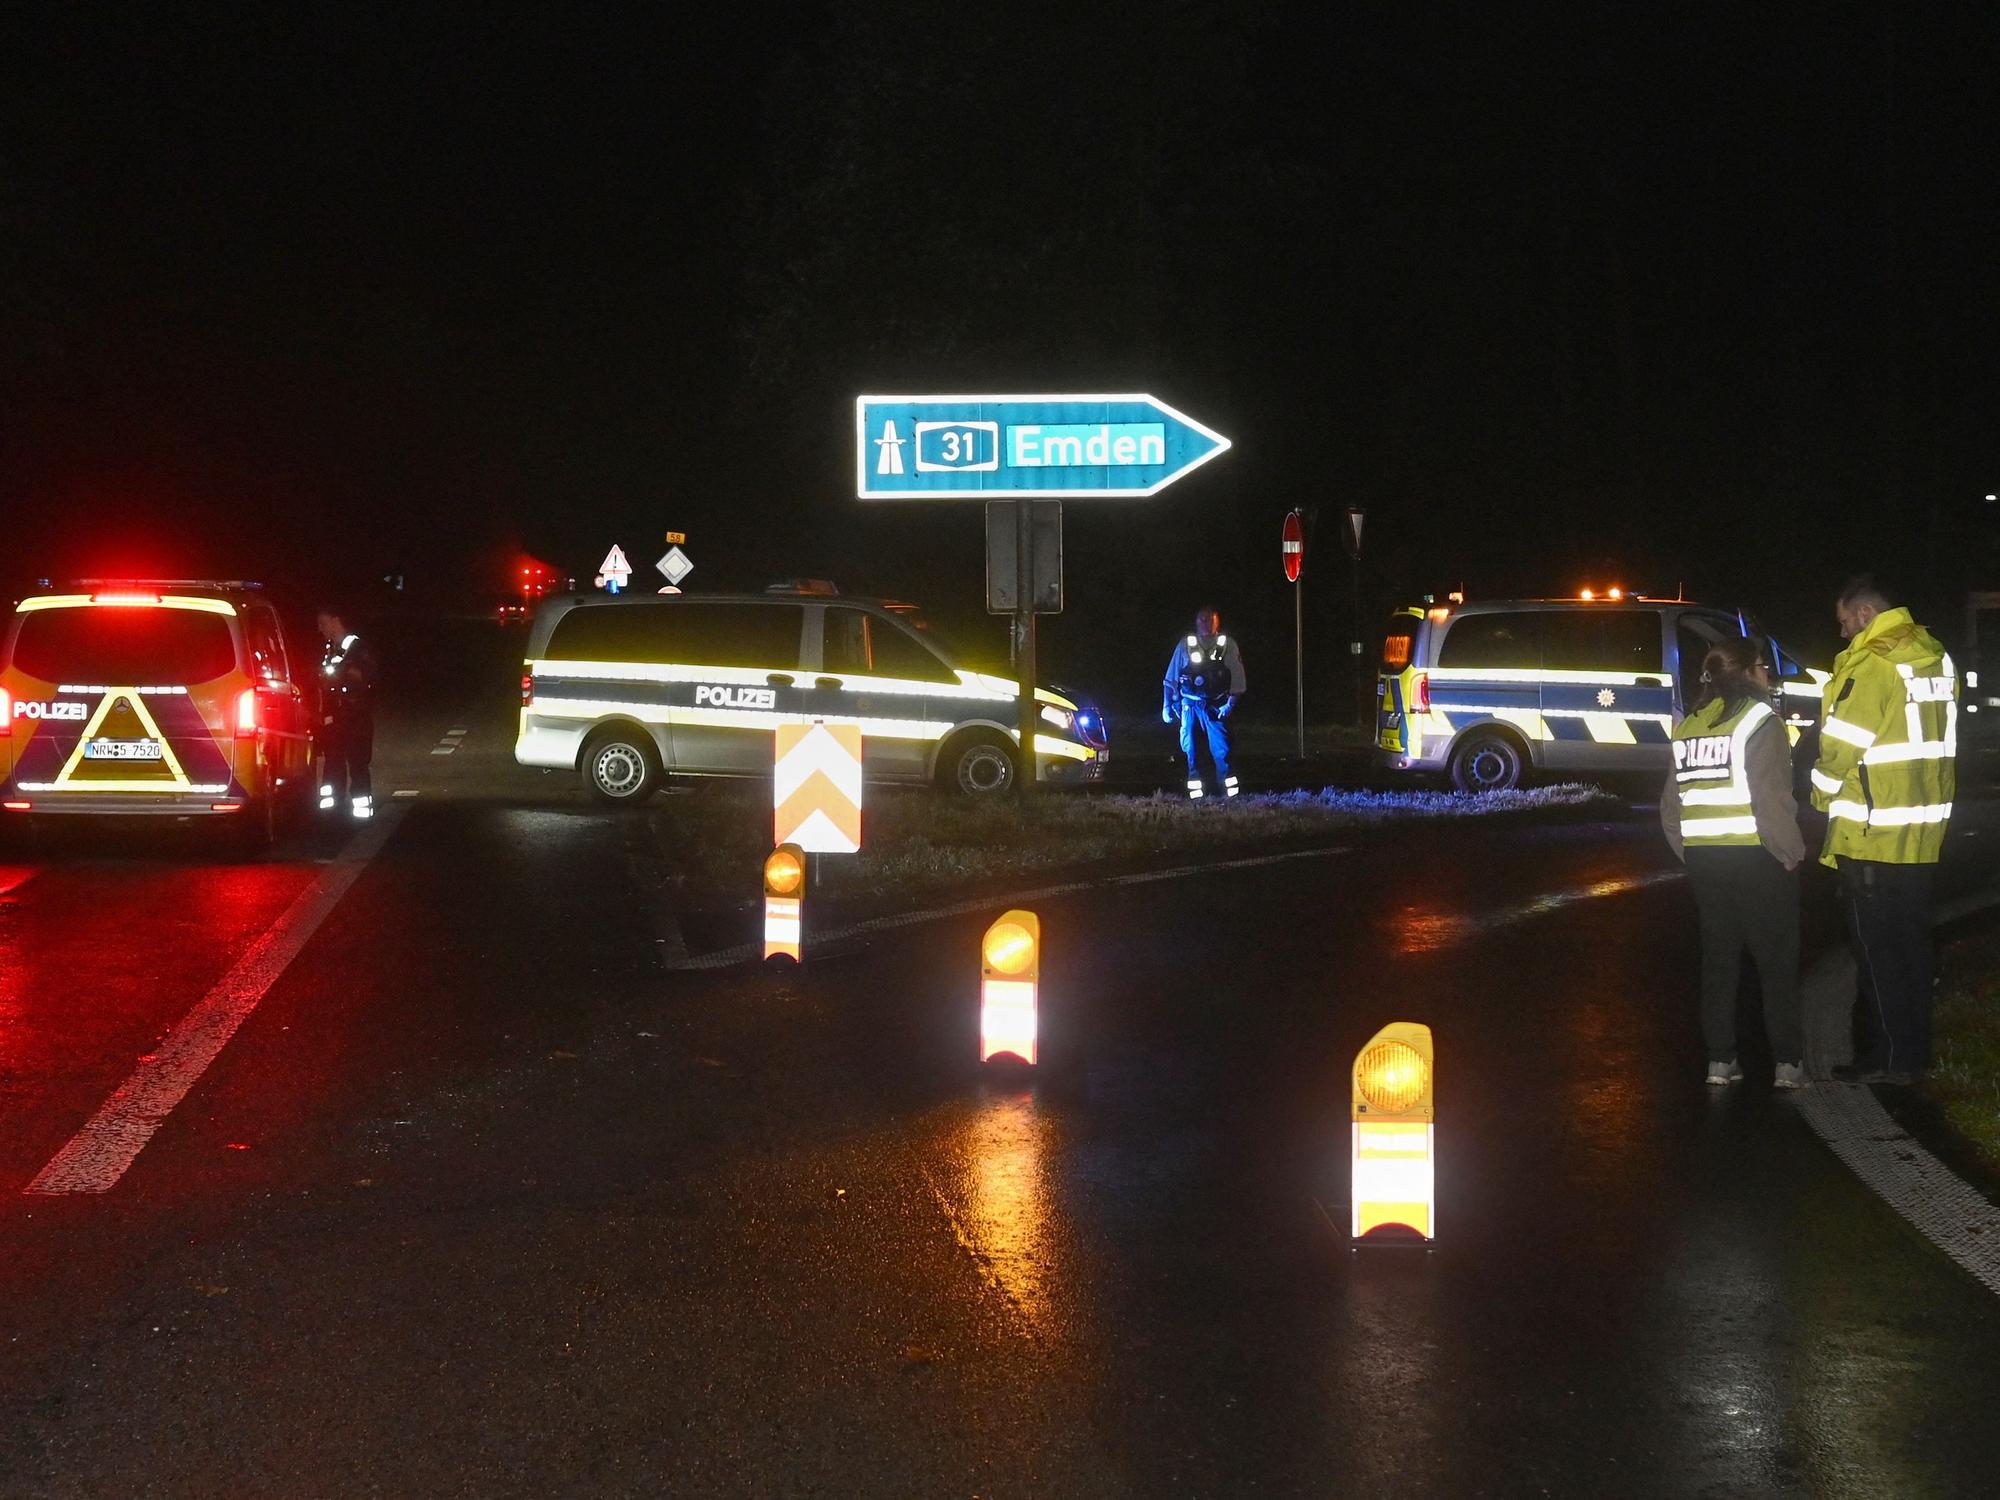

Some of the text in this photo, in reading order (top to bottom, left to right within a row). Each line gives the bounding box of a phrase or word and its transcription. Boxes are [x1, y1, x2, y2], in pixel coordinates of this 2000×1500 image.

[941, 426, 1163, 465] 31 Emden
[696, 686, 776, 709] POLIZEI
[14, 702, 87, 720] POLIZEI
